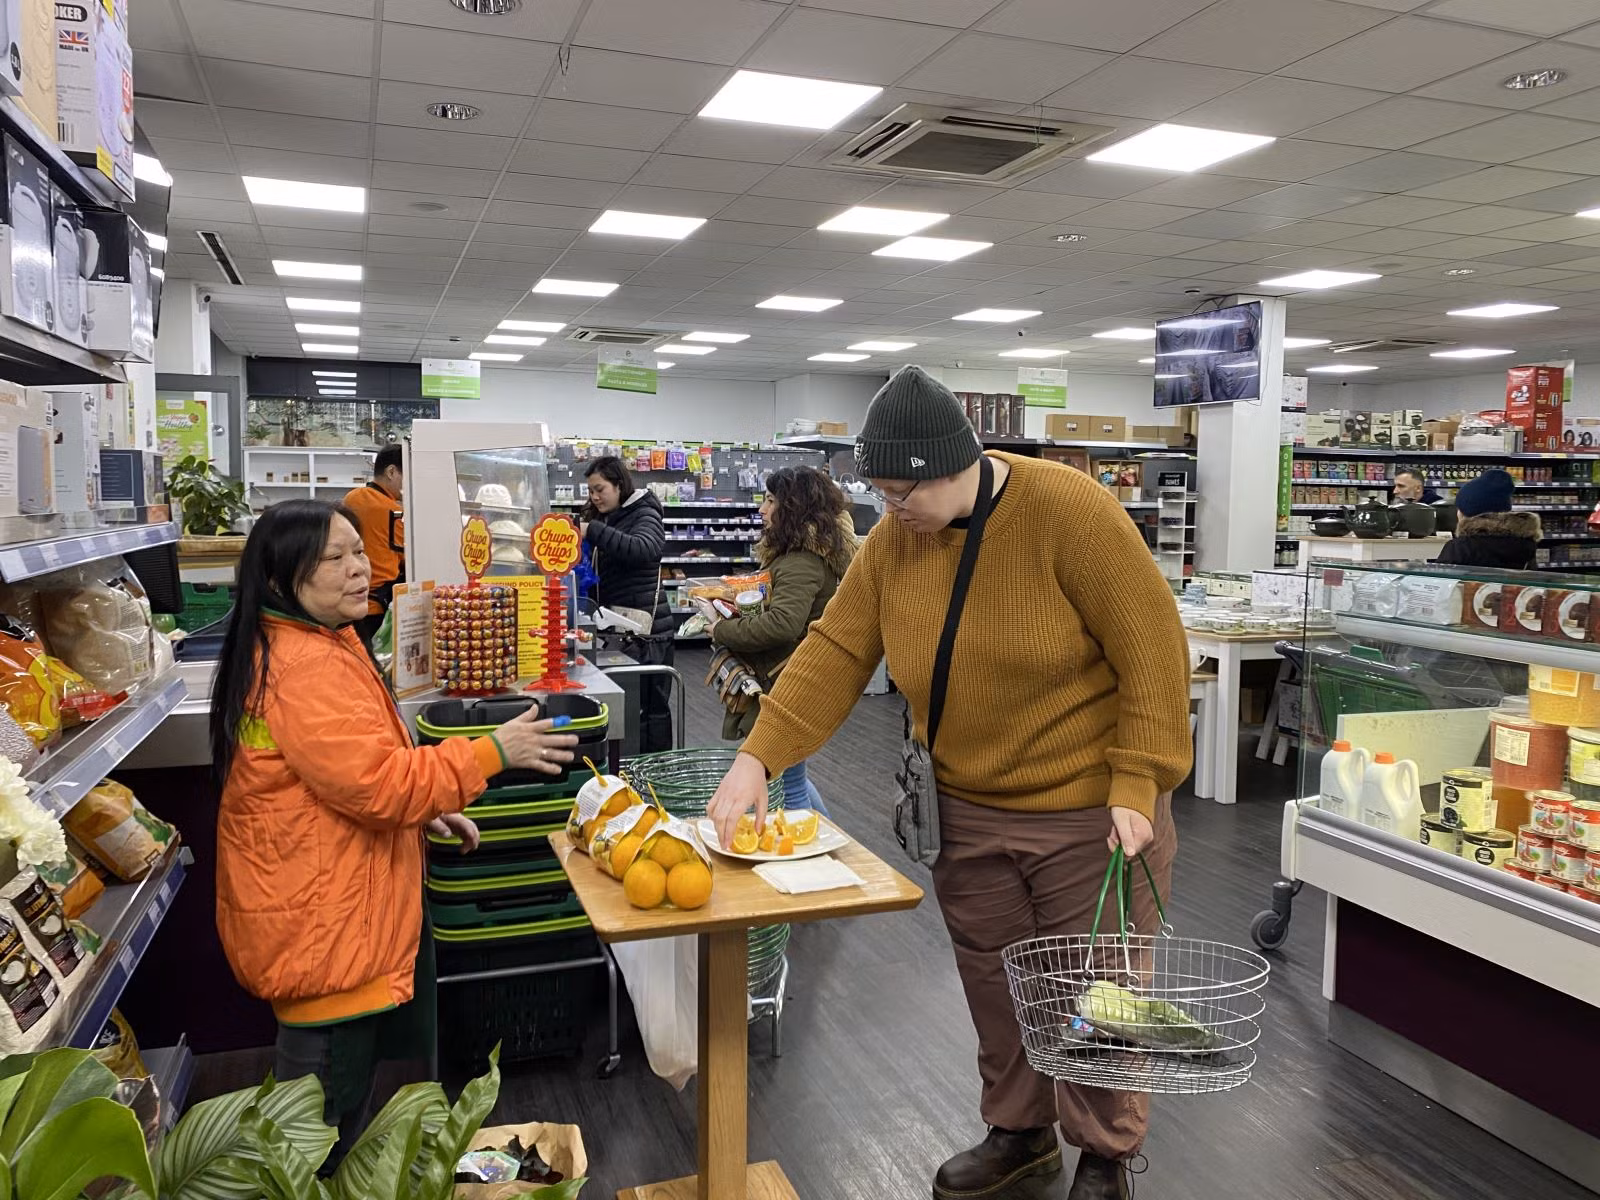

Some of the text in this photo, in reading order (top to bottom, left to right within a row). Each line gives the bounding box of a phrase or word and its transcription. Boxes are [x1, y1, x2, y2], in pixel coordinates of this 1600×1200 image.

[1281, 453, 1289, 511] ORGANIC
[465, 529, 488, 545] Chupa
[539, 529, 575, 546] Chupa
[463, 544, 486, 566] Chups
[537, 543, 572, 565] Chups
